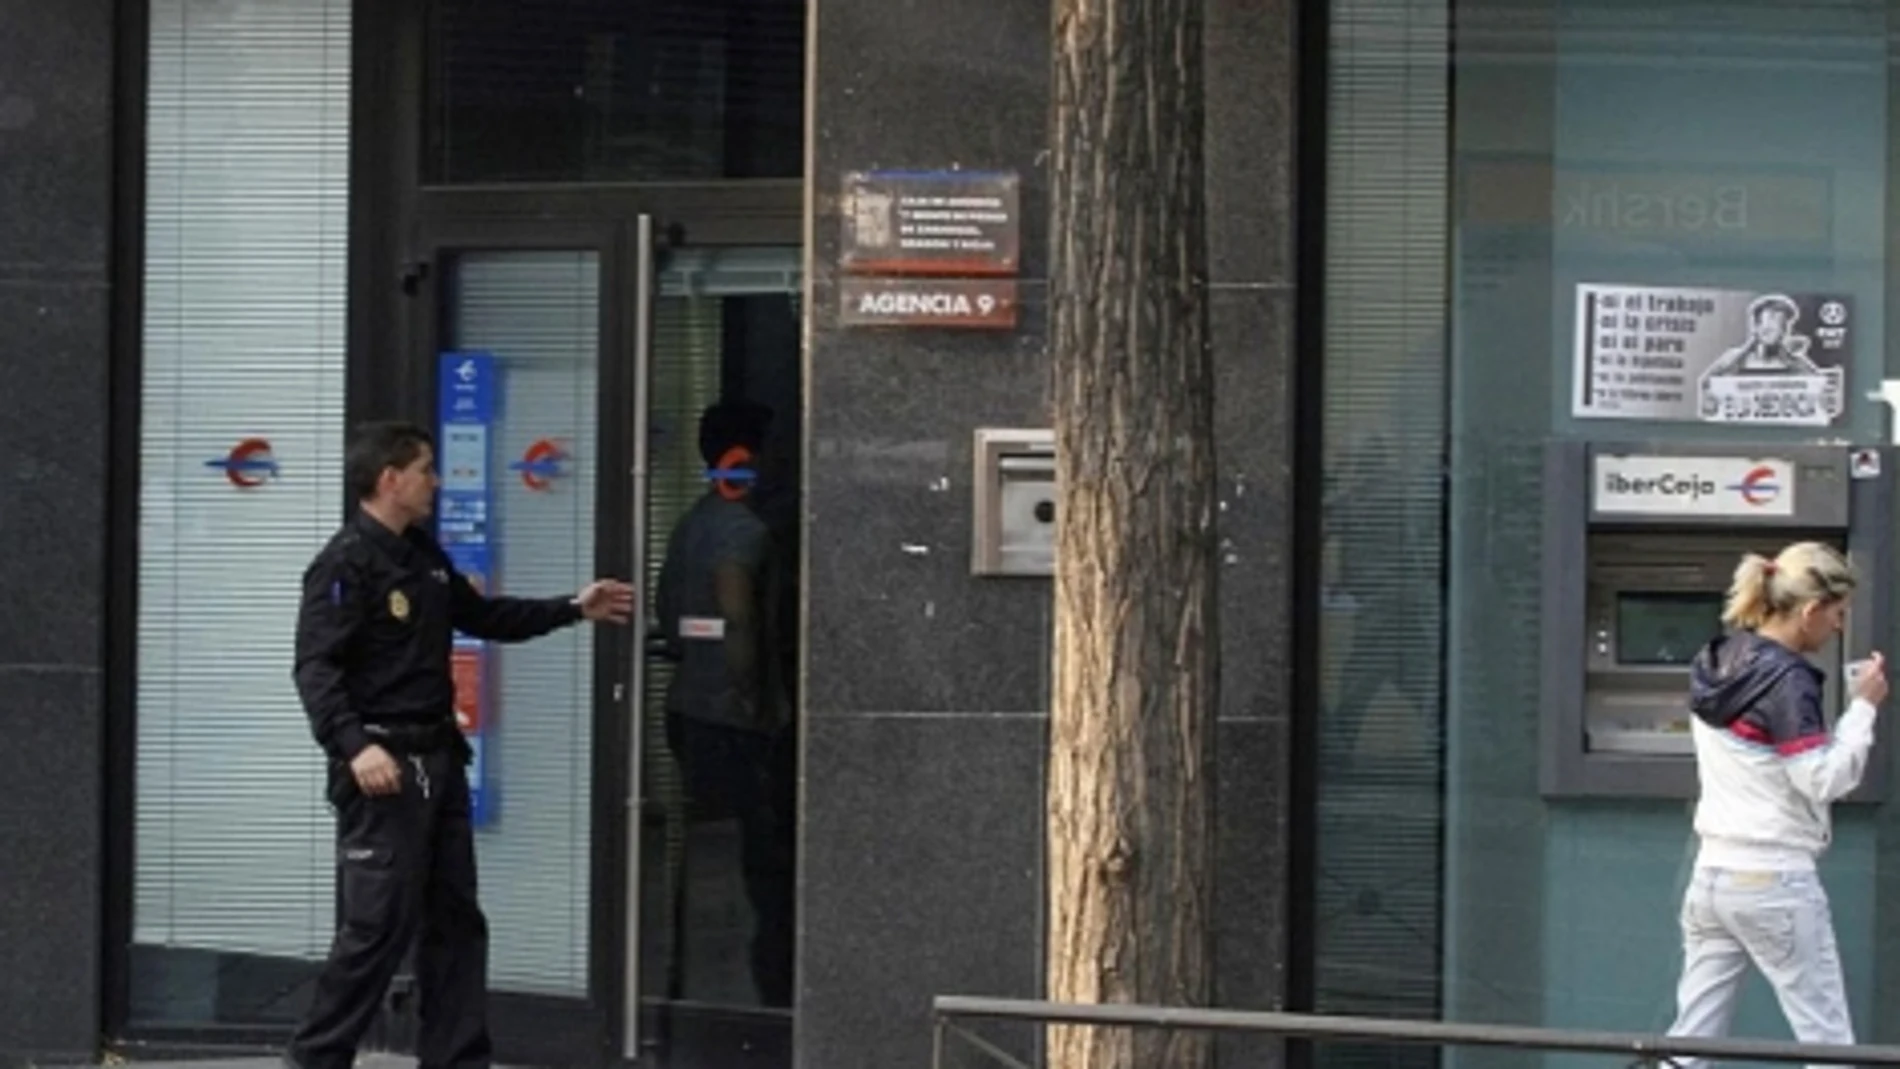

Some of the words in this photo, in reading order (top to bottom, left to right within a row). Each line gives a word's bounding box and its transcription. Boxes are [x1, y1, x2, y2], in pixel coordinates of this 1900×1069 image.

[859, 293, 972, 314] AGENCIA
[977, 294, 995, 315] 9
[1649, 294, 1714, 316] trabajo
[1605, 472, 1715, 500] iberCaja
